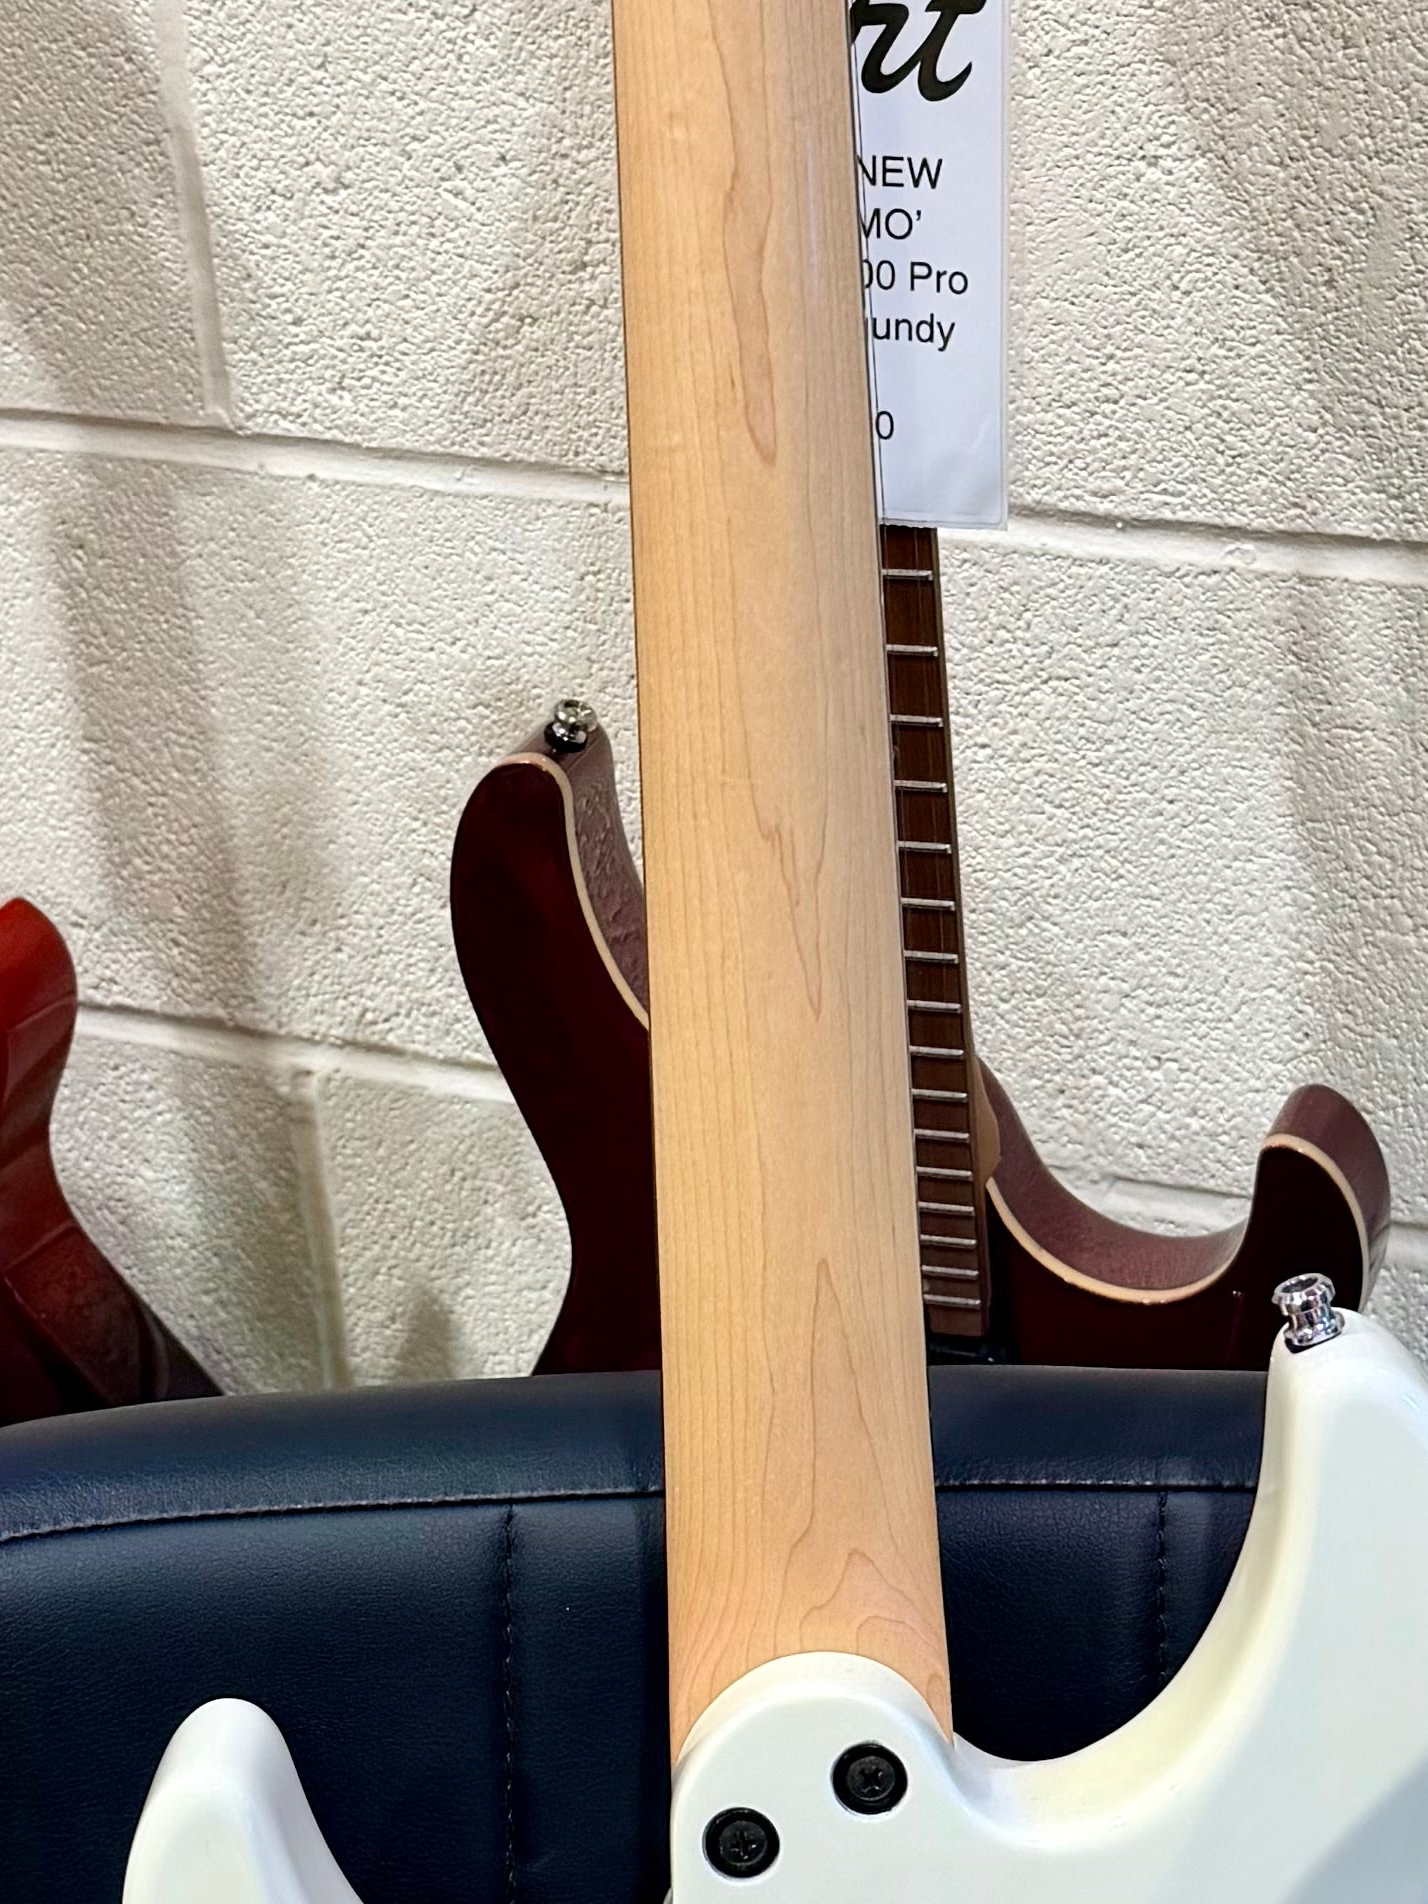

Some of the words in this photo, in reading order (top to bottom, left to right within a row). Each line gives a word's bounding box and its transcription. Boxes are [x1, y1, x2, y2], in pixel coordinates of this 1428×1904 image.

[857, 155, 943, 189] NEW
[910, 261, 968, 295] Pro
[865, 313, 955, 352] undy
